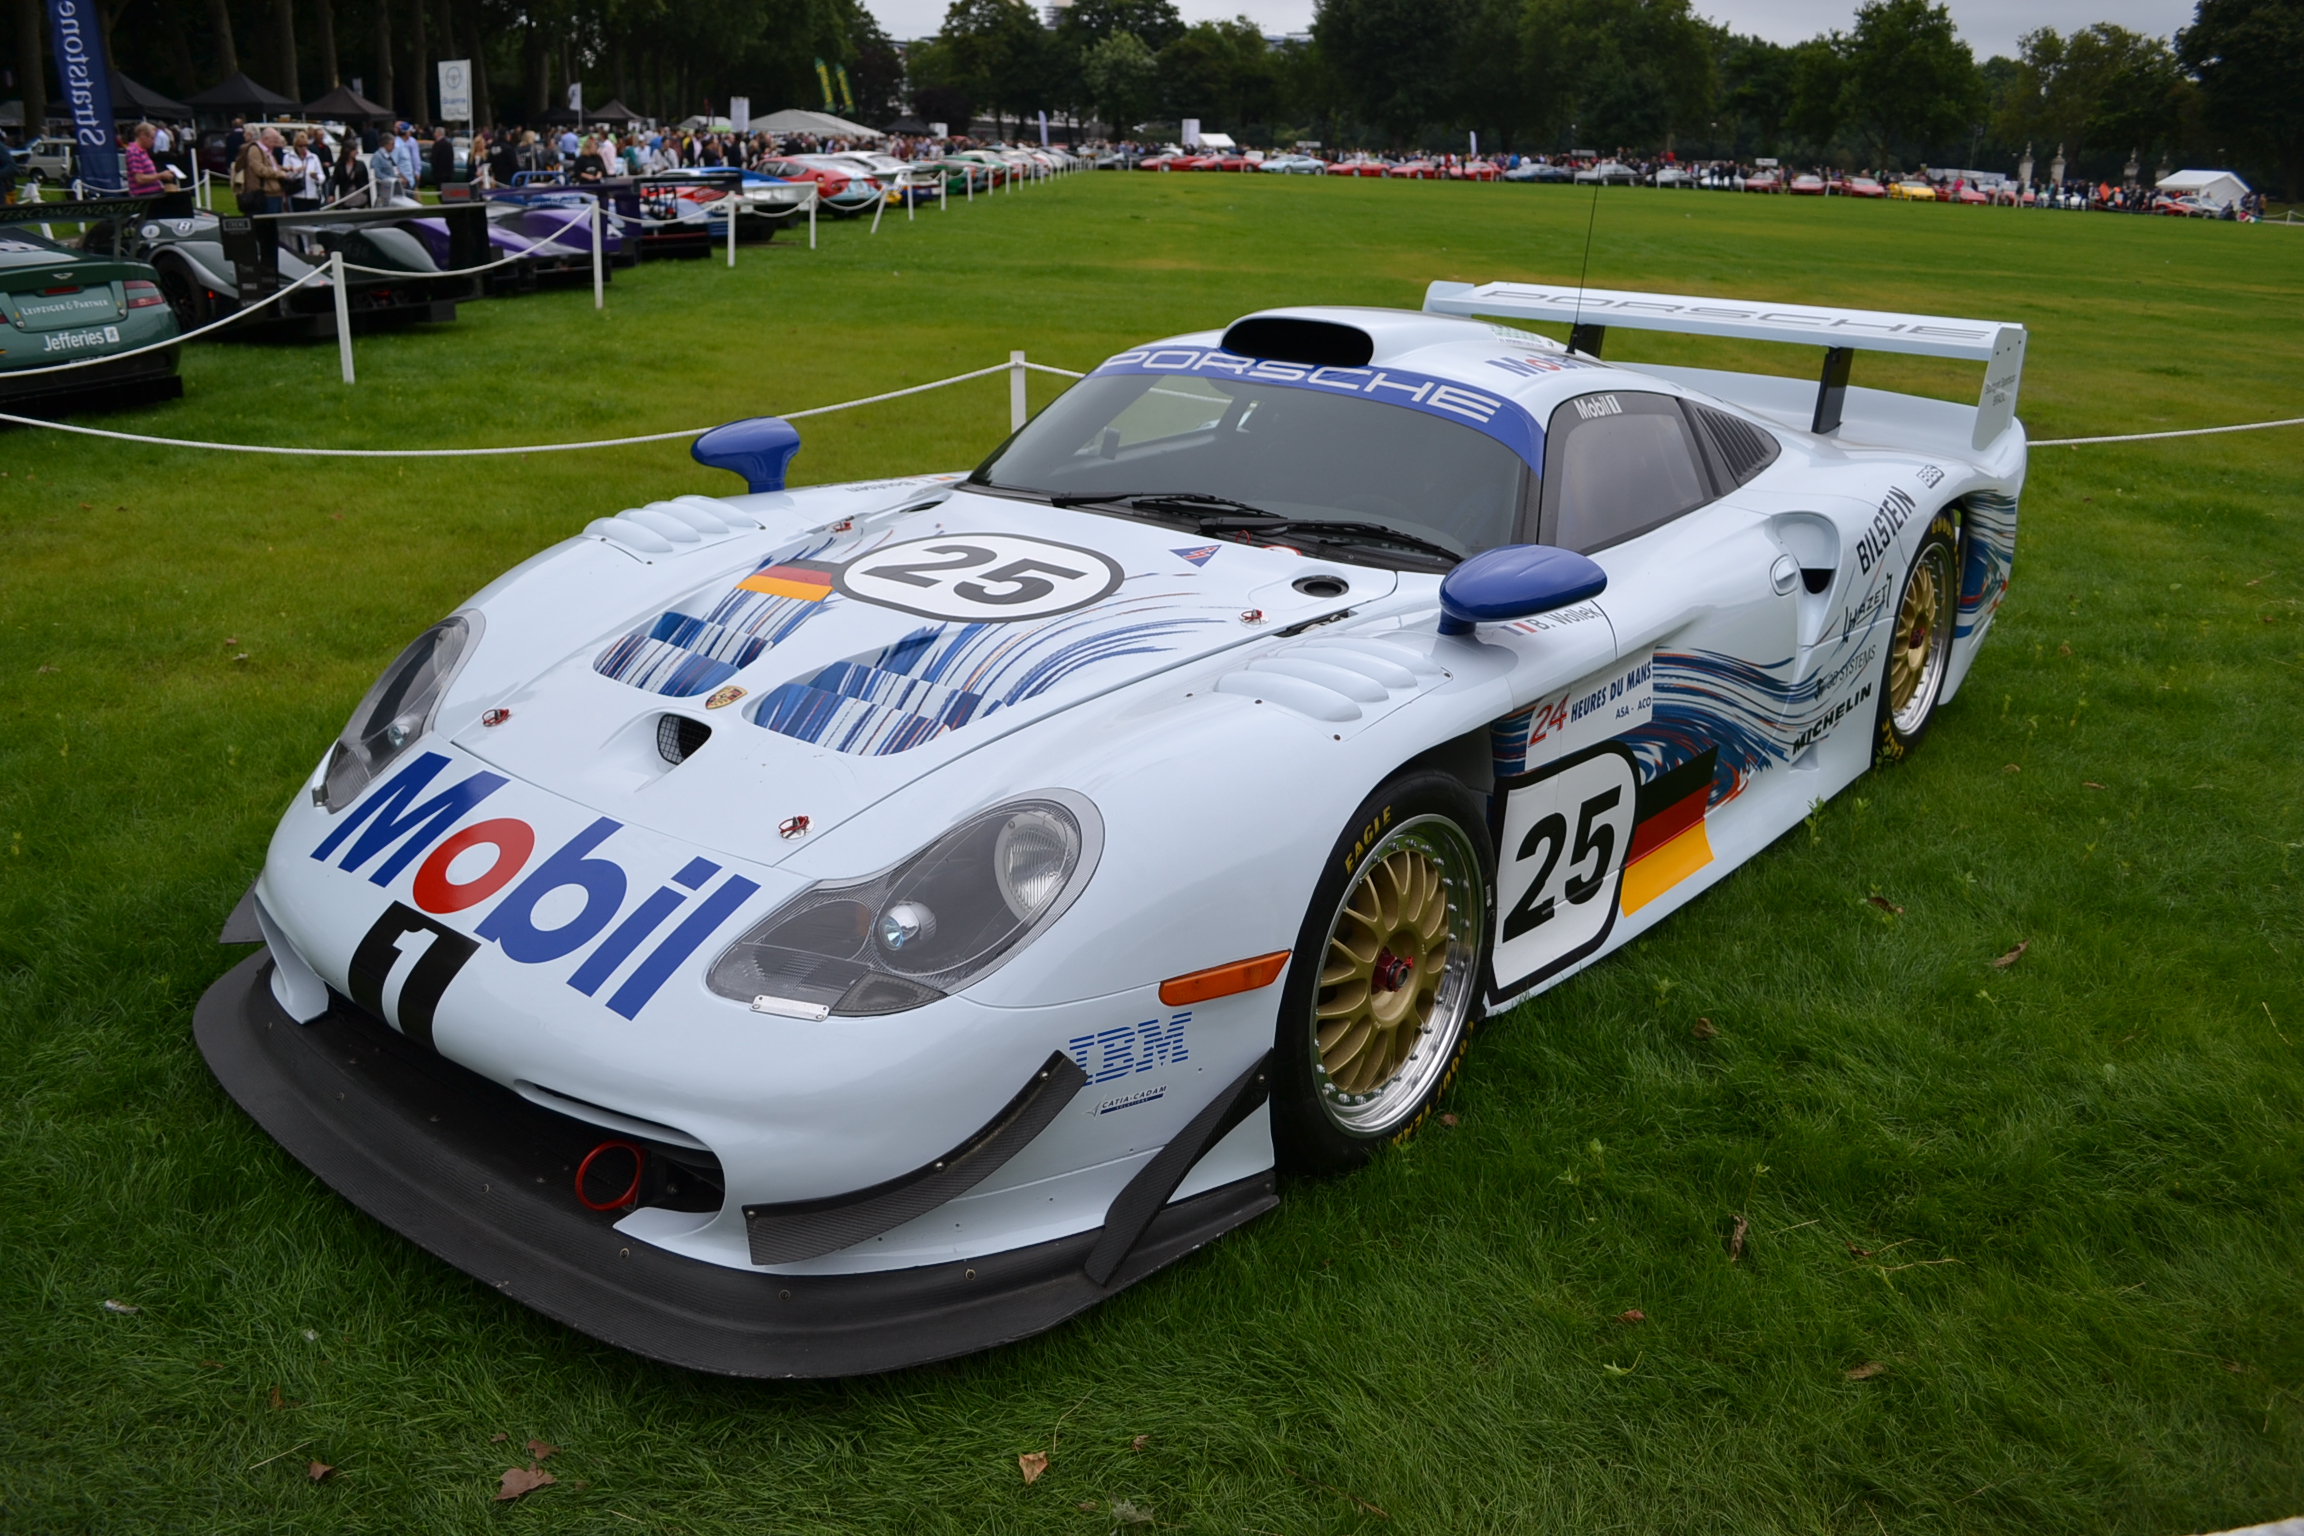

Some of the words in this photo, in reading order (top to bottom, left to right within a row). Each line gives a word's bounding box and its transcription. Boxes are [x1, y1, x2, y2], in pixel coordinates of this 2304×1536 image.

[44, 330, 105, 352] Jefferies
[1480, 290, 1992, 341] PORSCHE
[1096, 351, 1501, 423] PORSCHE
[1573, 395, 1610, 420] Mobil
[1856, 485, 1916, 576] BILSTEIN
[860, 544, 1089, 605] 25
[1525, 618, 1556, 630] B.
[1549, 604, 1604, 626] Wollek
[1839, 645, 1876, 682] SYSTEMS
[1528, 692, 1571, 748] 24
[1570, 686, 1607, 723] HEURES
[1610, 677, 1624, 702] DU
[1626, 660, 1652, 692] MANS
[1615, 705, 1630, 720] ASA
[1637, 696, 1652, 711] ACO
[1793, 682, 1873, 756] MICHELIN
[1344, 805, 1393, 875] EAGLE
[1502, 784, 1622, 943] 25
[310, 751, 762, 1021] Mobil
[1069, 1011, 1193, 1087] IBM
